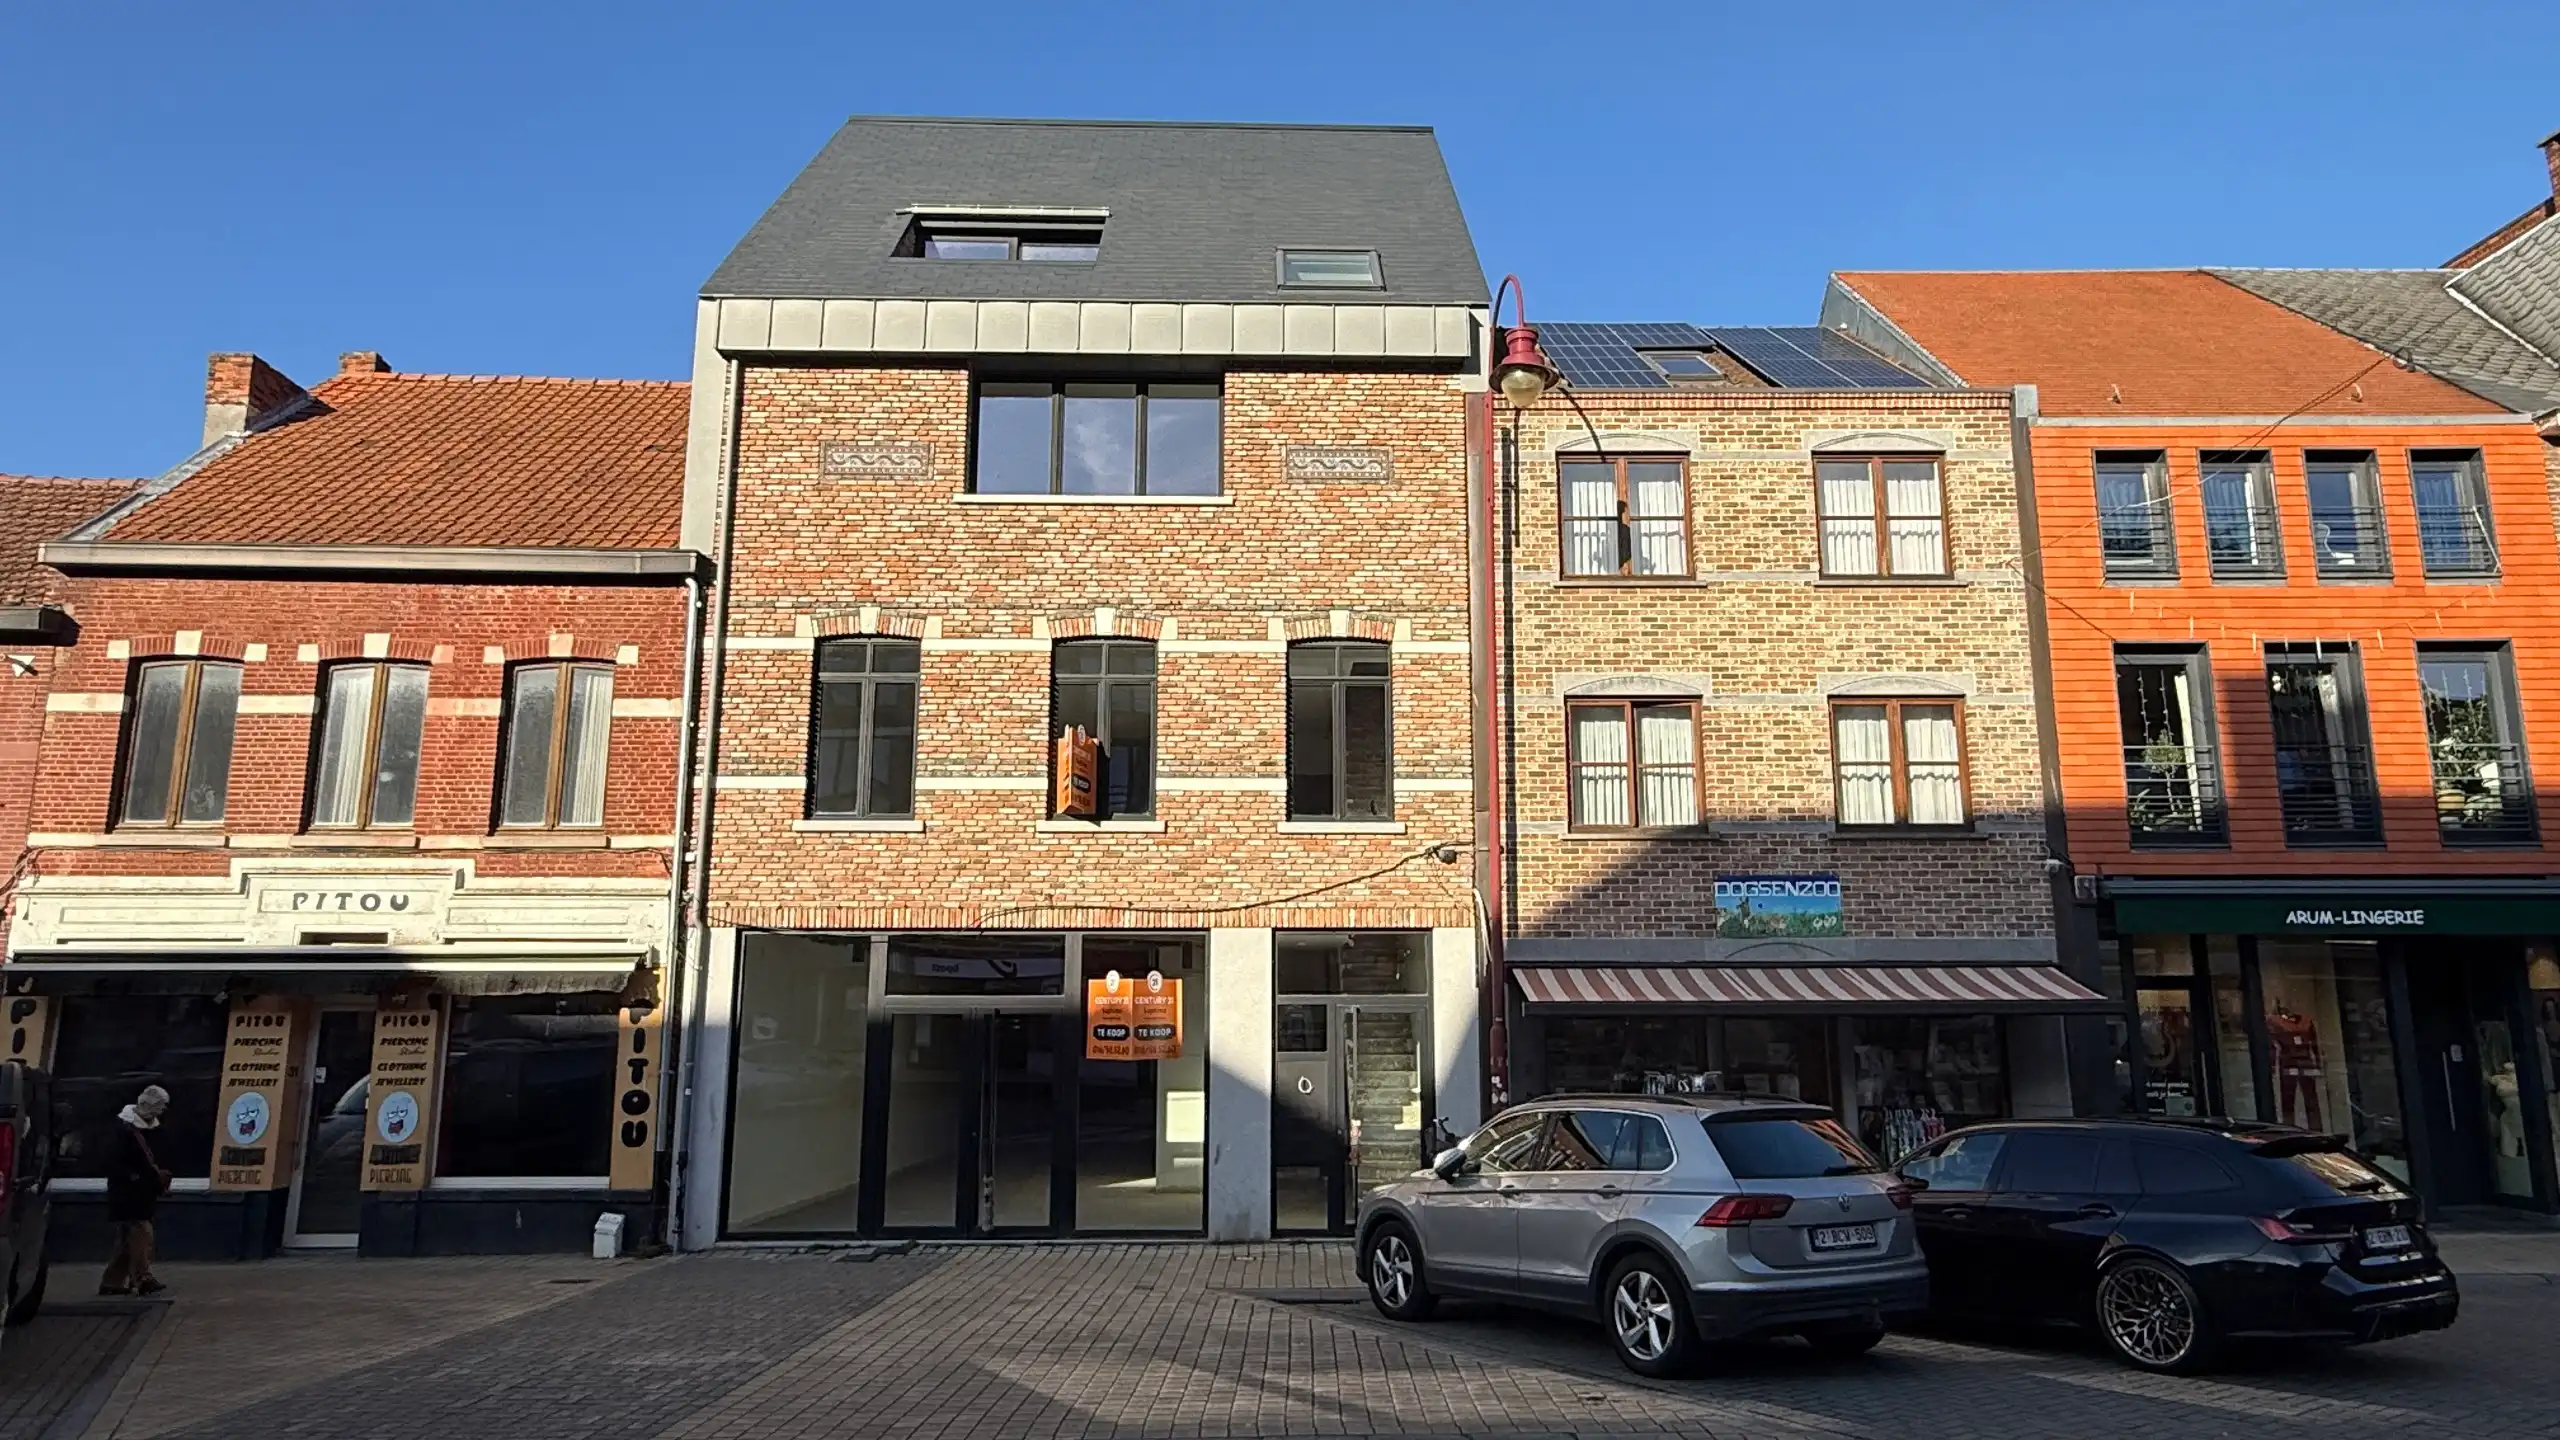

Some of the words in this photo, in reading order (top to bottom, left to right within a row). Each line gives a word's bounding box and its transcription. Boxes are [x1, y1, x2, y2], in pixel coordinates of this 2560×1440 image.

[1714, 881, 1841, 897] DOGSENZOO
[292, 892, 410, 912] PITOU
[2285, 909, 2425, 925] ARUM-LINGERIE
[1095, 996, 1123, 1005] CENTURY
[1135, 995, 1167, 1005] CENTURY
[236, 1014, 286, 1028] PITOU
[382, 1014, 431, 1028] PITOU
[1097, 1027, 1105, 1037] TE
[1106, 1028, 1126, 1038] KOOP
[1138, 1028, 1148, 1037] TE
[1149, 1027, 1172, 1037] KOOP
[233, 1037, 284, 1047] PIERCING
[380, 1037, 429, 1046] PIERCING
[228, 1062, 281, 1072] CLOTHING
[376, 1062, 428, 1072] CLOTHING
[226, 1078, 280, 1088] JEWELLERY
[375, 1076, 427, 1087] JEWELLERY
[369, 1168, 413, 1184] PIERCING
